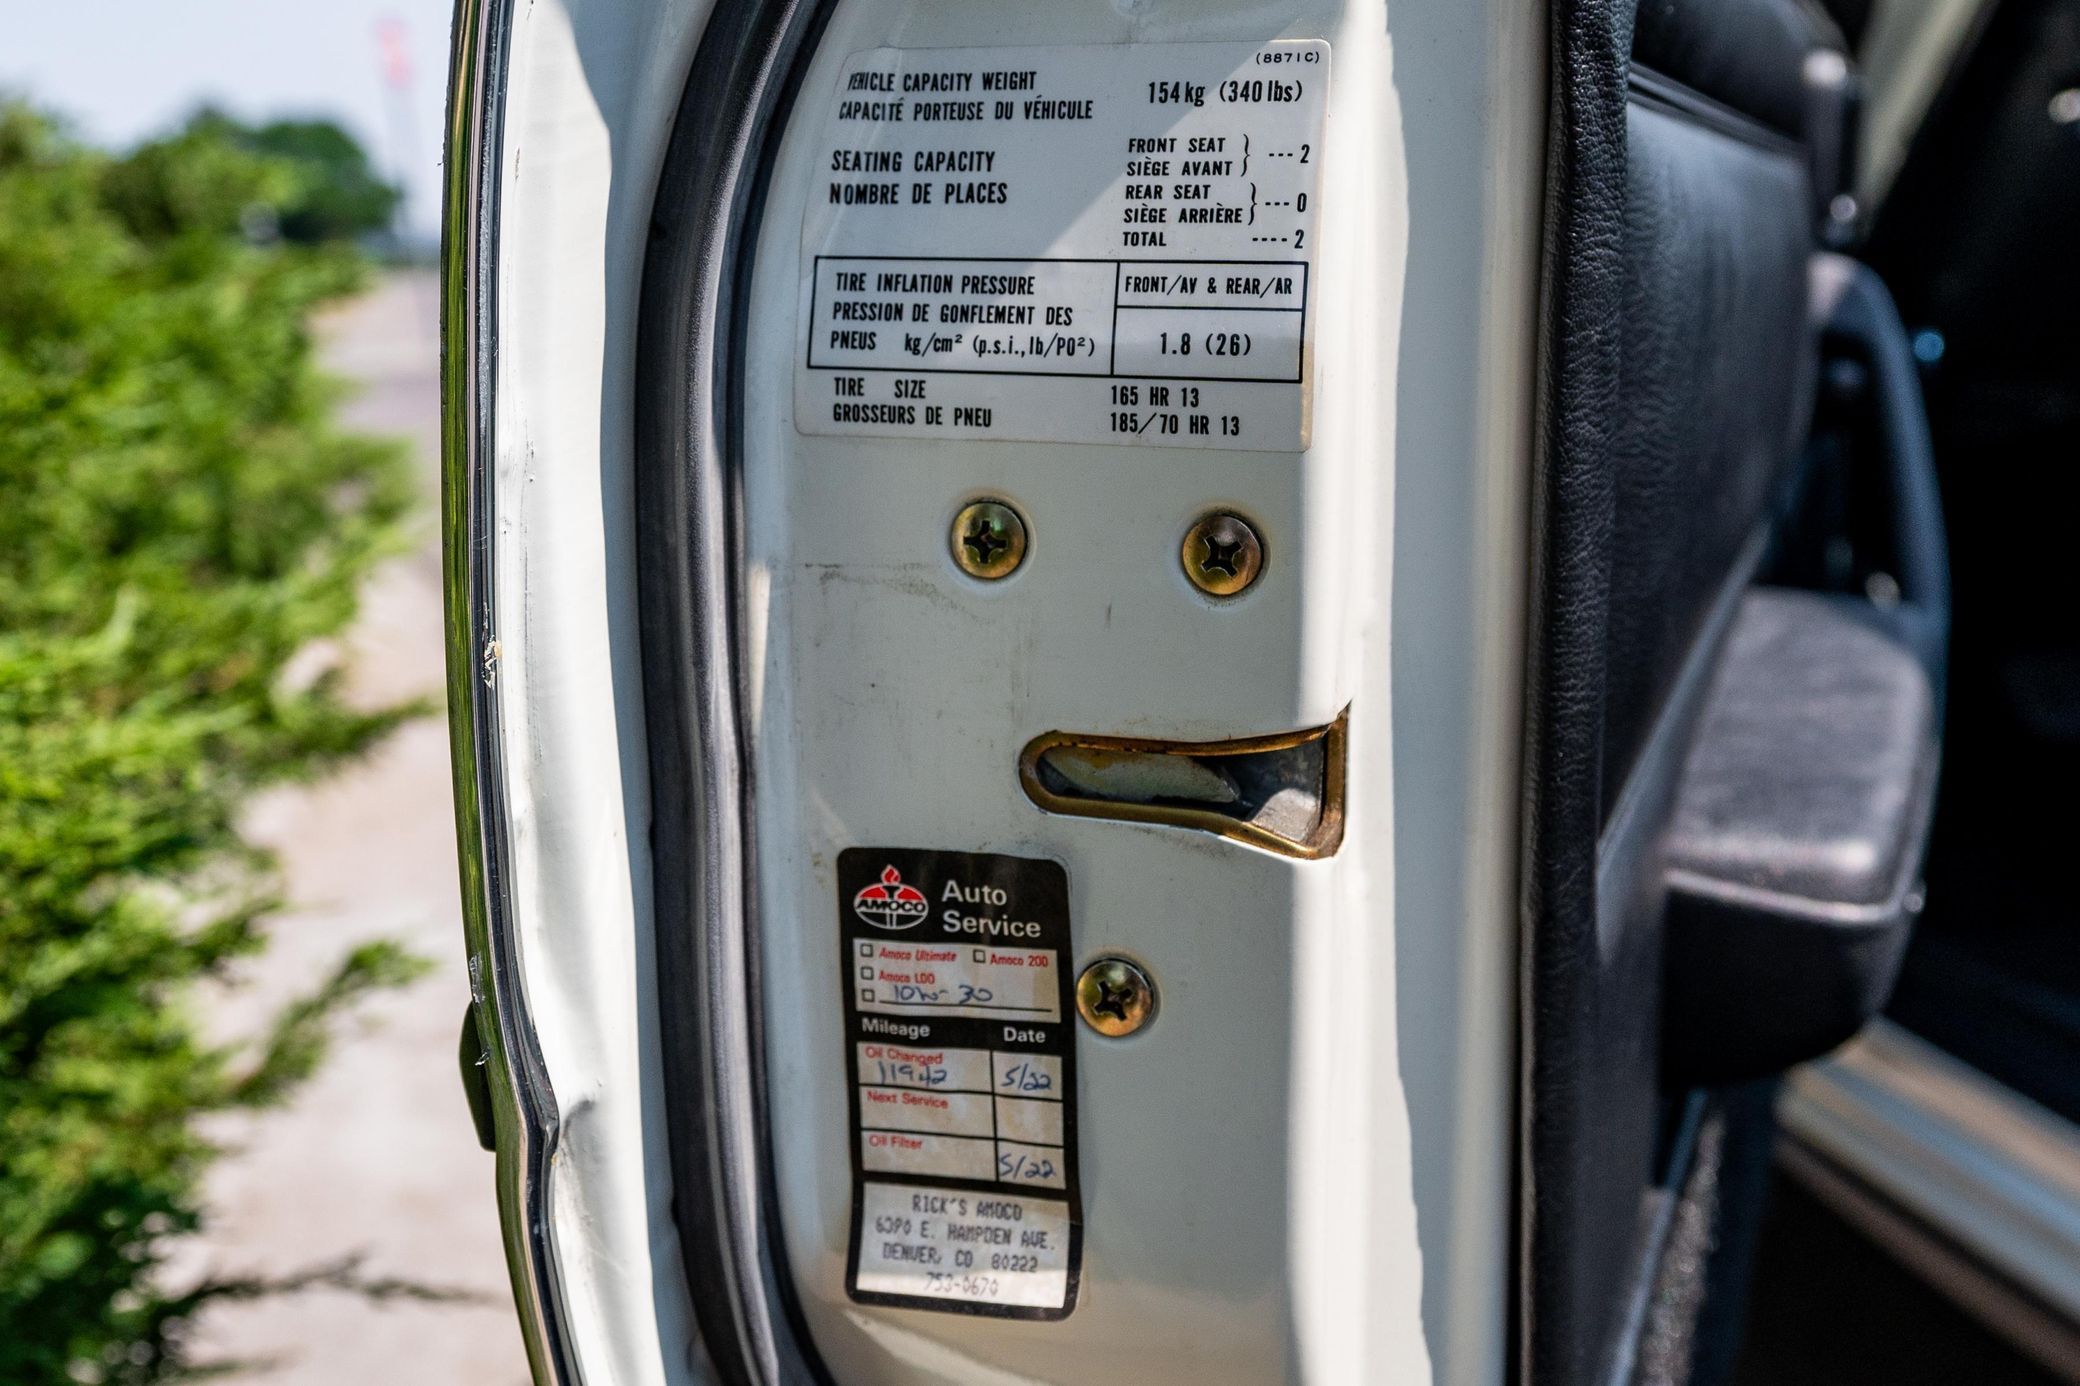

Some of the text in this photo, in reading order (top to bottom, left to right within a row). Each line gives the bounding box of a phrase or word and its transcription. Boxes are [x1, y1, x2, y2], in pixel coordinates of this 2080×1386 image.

[1256, 52, 1320, 64] (8871C)
[903, 72, 972, 92] CAPACITY
[982, 71, 1037, 91] WEIGHT
[839, 95, 1093, 121] CAPACITÉ PORTEUSE DU VÉHICULE
[1129, 138, 1177, 153] FRONT
[1188, 138, 1226, 152] SEAT
[832, 150, 995, 172] SEATING CAPACITY
[1127, 156, 1232, 176] SIÈGE AVANT
[830, 182, 1007, 205] NOMBRE DE PLACES
[1126, 185, 1163, 200] REAR
[1173, 184, 1211, 200] SEAT
[1124, 203, 1243, 223] SIÈGE ARRIÈRE
[1123, 232, 1167, 246] TOTAL
[837, 272, 1035, 295] TIRE INFLATION PRESSURE
[1125, 275, 1292, 298] FRONT/AV & REAR/AR
[833, 302, 1073, 326] PRESSION DE GONFLEMENT DES
[830, 331, 876, 349] PNEUS
[1160, 332, 1251, 356] 1.8 (26)
[834, 377, 926, 399] TIRE SIZE
[1111, 385, 1199, 407] 165 HR 13
[833, 403, 992, 427] GROSSEURS DE PNEU
[1110, 412, 1240, 436] 185/70 HR 13
[941, 880, 1007, 906] Auto
[856, 900, 926, 913] AMOCO
[943, 910, 1041, 938] Service
[879, 948, 957, 963] Amoco Ultimate
[990, 954, 1048, 967] Amoco 200
[879, 970, 910, 983] Amoco
[862, 1018, 1046, 1043] Mileage Date
[865, 1046, 943, 1066] Oil Changed
[867, 1091, 948, 1109] Next Service
[869, 1135, 922, 1150] Oil Filter
[912, 1195, 1023, 1221] RICK'S AMOCO
[921, 1224, 935, 1239] E.
[947, 1225, 1011, 1245] HAMPDEN
[955, 1251, 973, 1267] CO
[991, 1256, 1038, 1272] 80222
